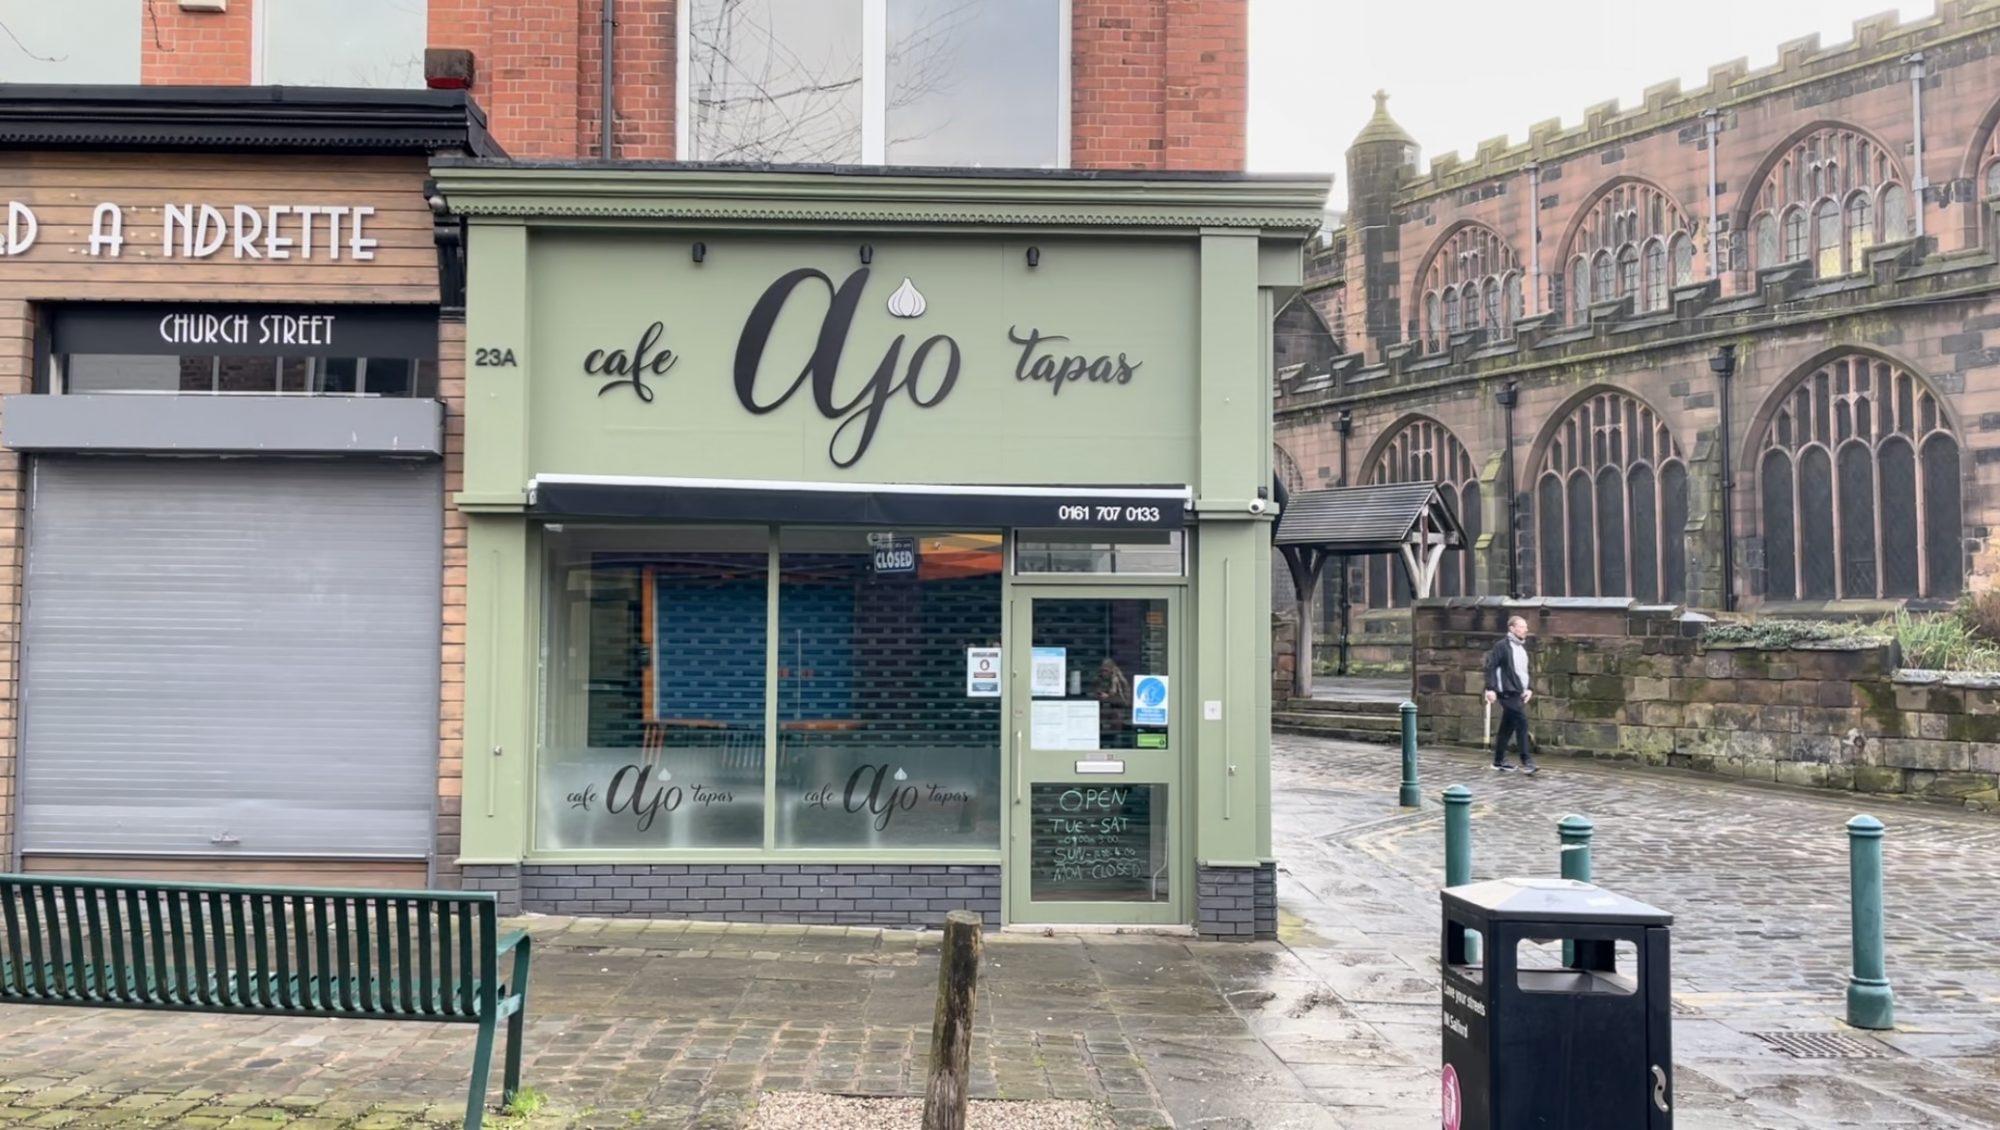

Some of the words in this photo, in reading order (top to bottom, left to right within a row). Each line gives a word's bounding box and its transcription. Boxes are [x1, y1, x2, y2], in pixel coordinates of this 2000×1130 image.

[88, 202, 124, 256] A
[163, 203, 378, 260] NDRETTE
[160, 314, 249, 344] CHURCH
[259, 315, 336, 345] STREET
[475, 347, 517, 368] 23A
[584, 321, 679, 403] cafe
[1008, 325, 1144, 396] tapas
[1058, 505, 1090, 521] 0161
[1096, 506, 1122, 521] 707
[1126, 507, 1160, 522] 0133
[876, 551, 912, 568] CLOSED
[567, 783, 597, 811] cafe
[690, 783, 733, 805] tapas
[804, 783, 833, 810] cafe
[927, 782, 969, 804] tapas
[1059, 788, 1128, 812] OPEN
[1100, 816, 1129, 834] SAT
[1092, 862, 1141, 880] CLOSED
